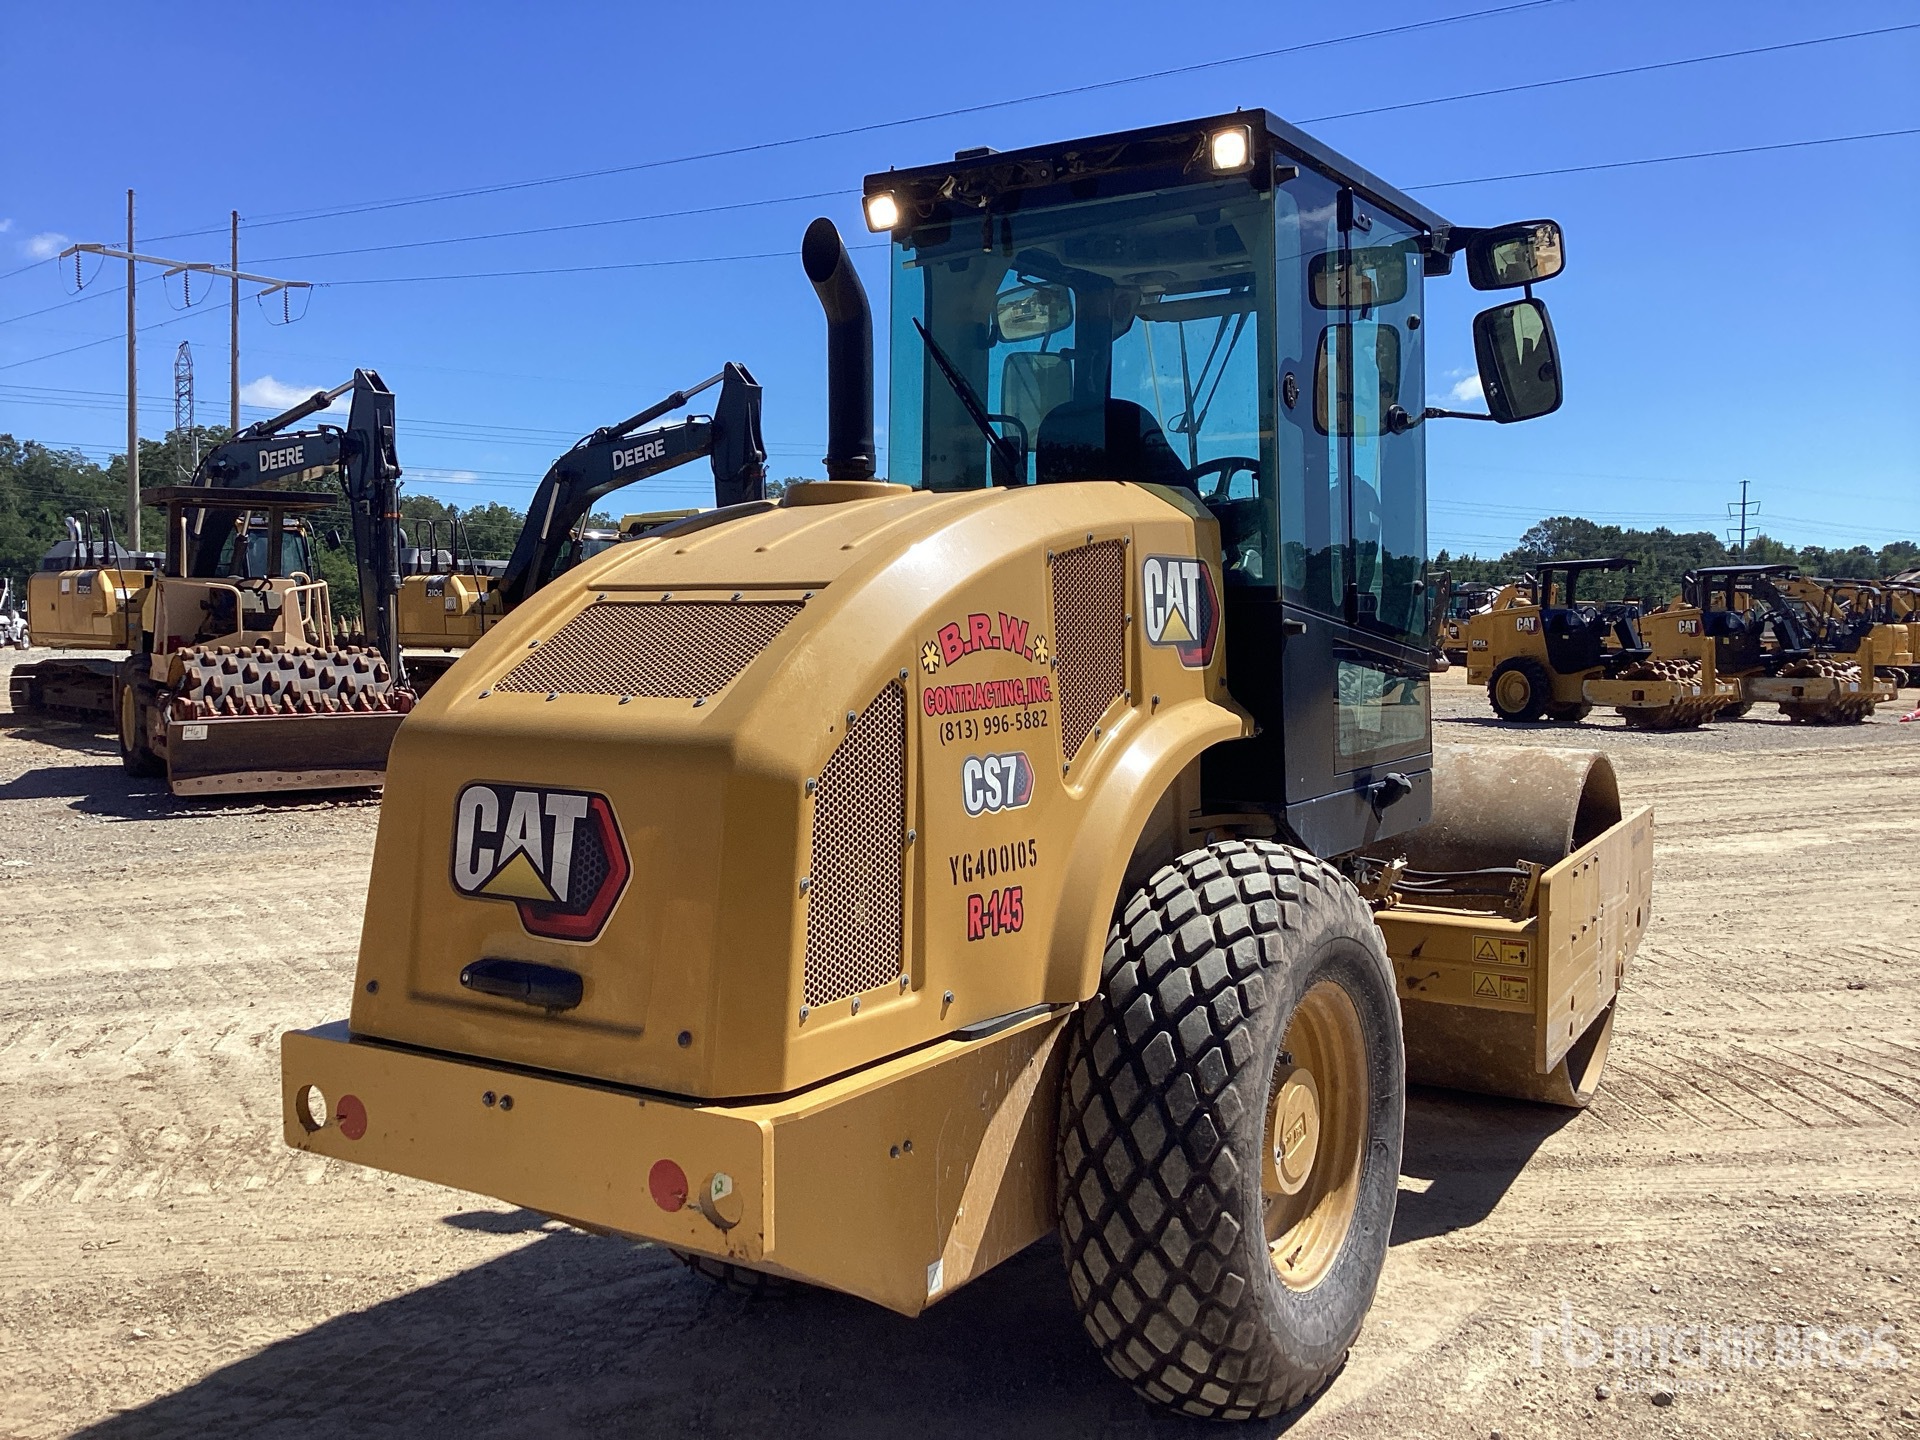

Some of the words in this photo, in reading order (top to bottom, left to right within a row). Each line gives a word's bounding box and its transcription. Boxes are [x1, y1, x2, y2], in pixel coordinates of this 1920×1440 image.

[259, 445, 304, 472] DEERE
[613, 438, 666, 471] DEERE
[427, 588, 443, 597] 210G
[1144, 557, 1202, 642] CAT
[937, 611, 1034, 666] B.R.W.
[1516, 617, 1536, 632] CAT
[1678, 620, 1697, 634] CAT
[938, 718, 979, 746] (813)
[983, 709, 1048, 737] 996-5882
[963, 756, 1017, 813] CS7
[454, 785, 589, 903] CAT
[949, 839, 1038, 886] YG400105
[967, 886, 1024, 942] R-145
